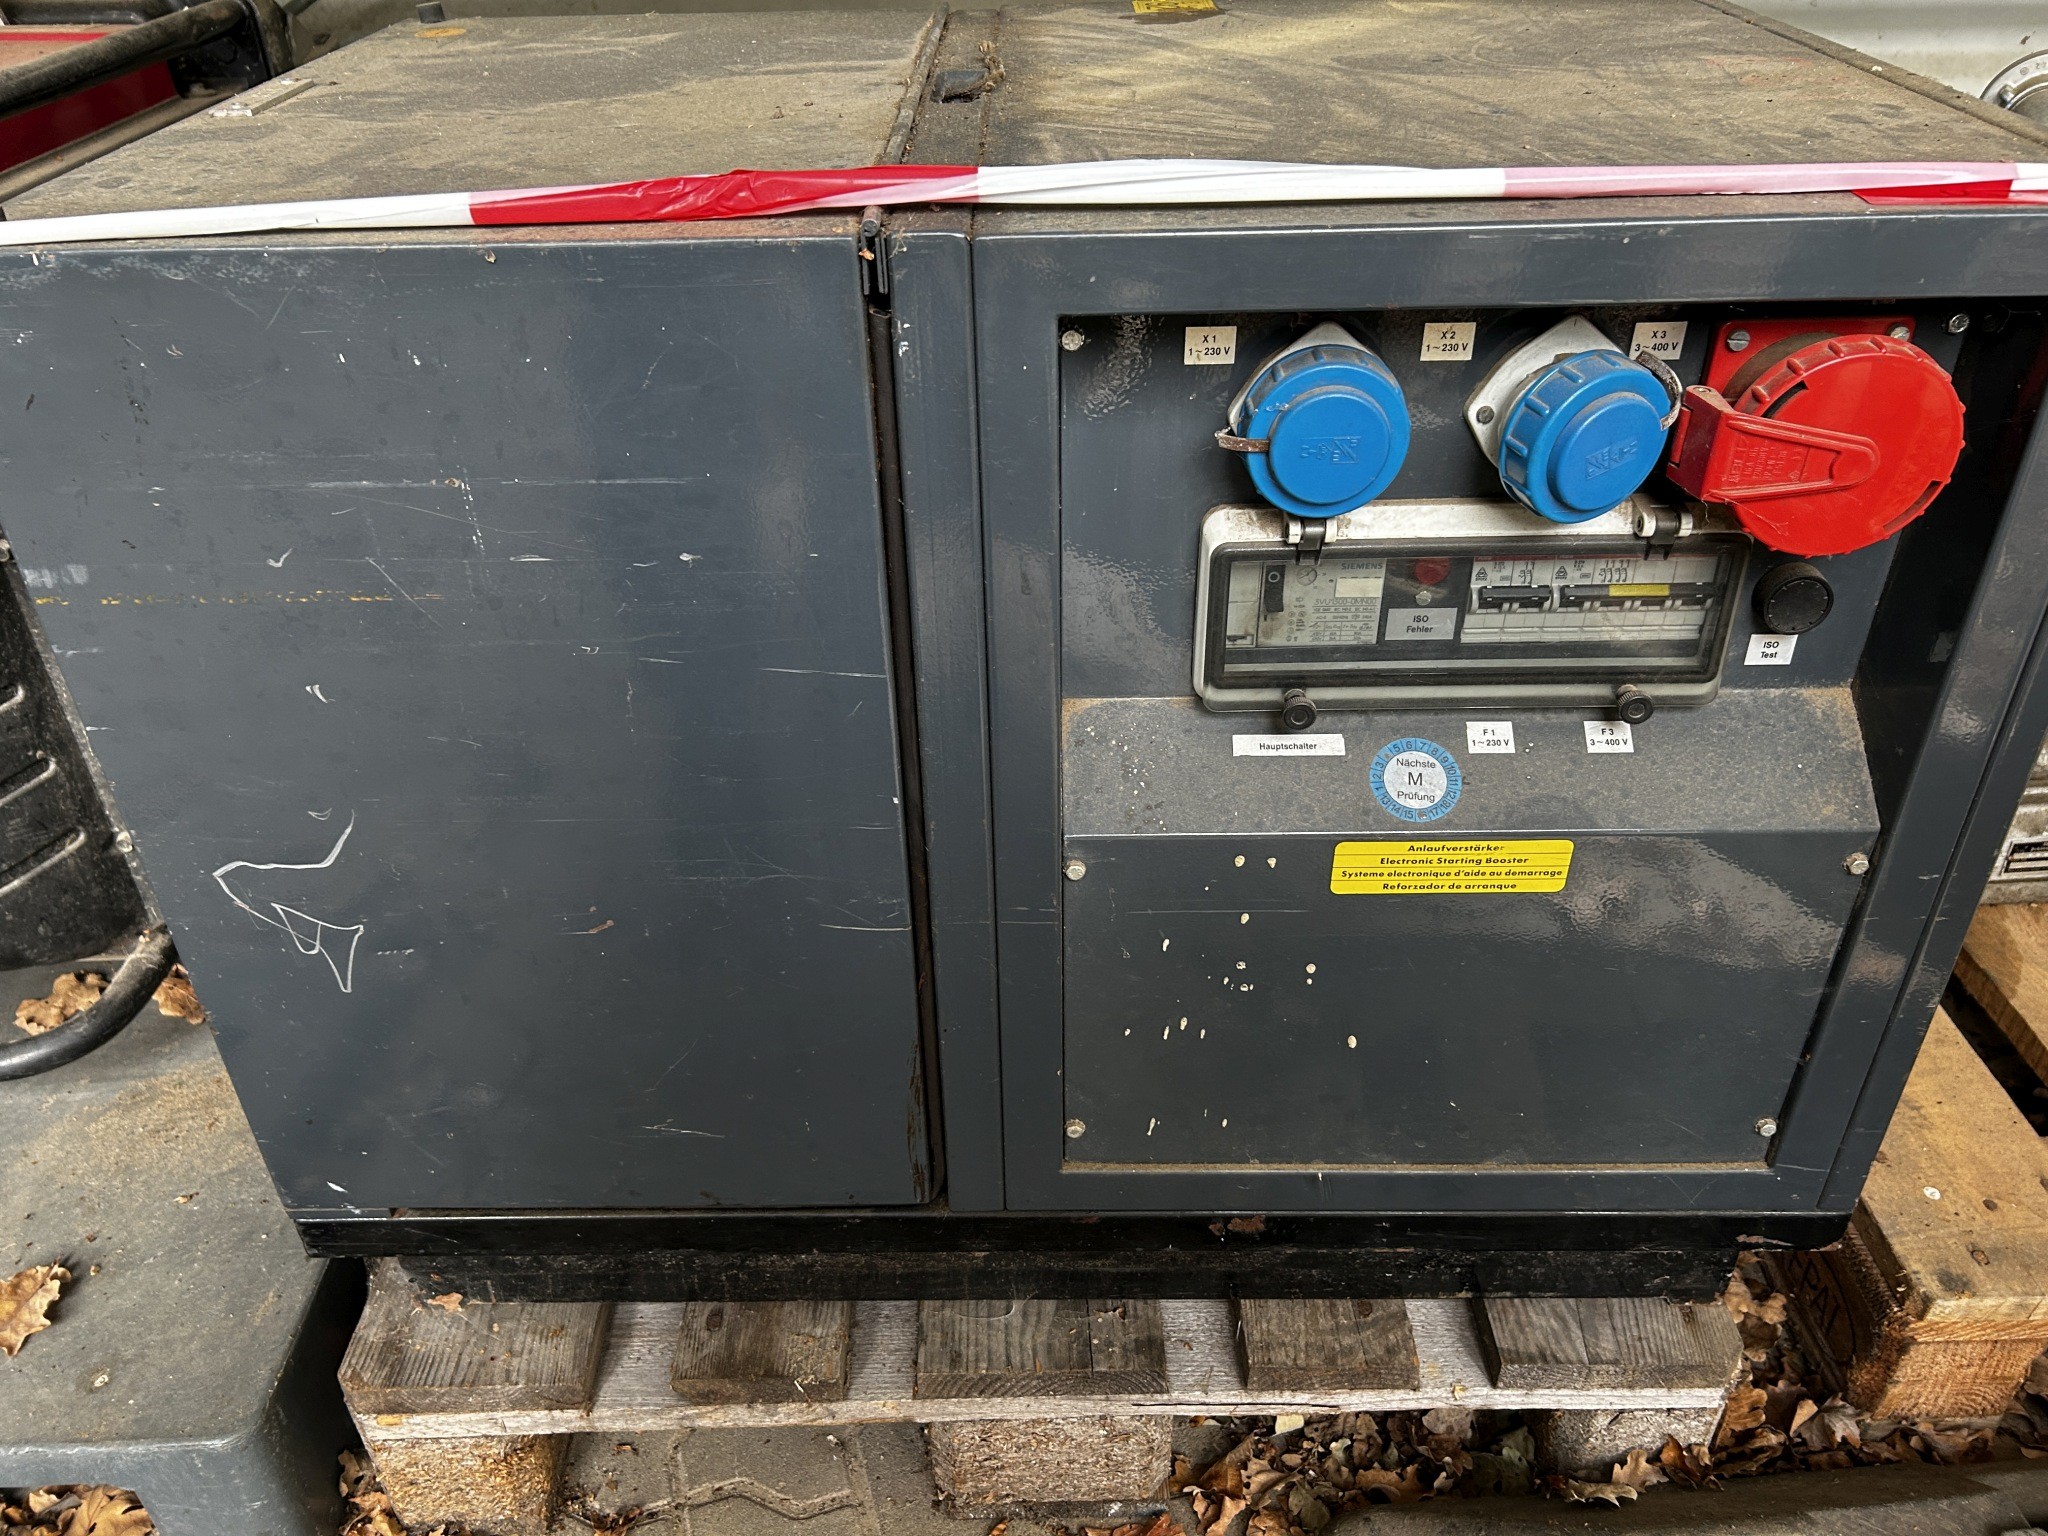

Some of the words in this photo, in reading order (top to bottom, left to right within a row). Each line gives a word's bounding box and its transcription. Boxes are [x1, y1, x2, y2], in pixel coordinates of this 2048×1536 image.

[1202, 334, 1209, 344] X
[1212, 334, 1217, 343] 1
[1440, 330, 1448, 340] X
[1450, 330, 1456, 340] 2
[1651, 330, 1659, 339] X
[1660, 330, 1667, 339] 3
[1223, 346, 1231, 355] V
[1462, 342, 1469, 351] V
[1671, 341, 1679, 351] V
[1341, 562, 1383, 570] SIEMENS
[1412, 614, 1429, 623] ISO
[1406, 625, 1434, 633] Fehler
[1763, 641, 1780, 649] ISO
[1760, 651, 1778, 659] Test
[1483, 728, 1489, 736] F
[1491, 728, 1495, 736] 1
[1601, 728, 1607, 736] F
[1608, 728, 1615, 736] 3
[1405, 740, 1413, 750] 6
[1419, 741, 1427, 750] 7
[1503, 739, 1510, 747] V
[1622, 738, 1628, 746] V
[1259, 742, 1318, 752] Hauptschalter
[1392, 743, 1401, 753] 5
[1431, 747, 1439, 756] 8
[1396, 758, 1436, 769] Nächste
[1440, 756, 1449, 764] 9
[1375, 761, 1384, 769] 3
[1447, 765, 1457, 775] 10
[1408, 771, 1423, 786] M
[1449, 778, 1459, 786] 11
[1397, 790, 1436, 804] Prüfung
[1447, 790, 1458, 800] 12
[1381, 795, 1391, 805] 13
[1390, 804, 1400, 813] 14
[1404, 810, 1414, 819] 15
[1430, 807, 1439, 816] 17
[1440, 800, 1451, 810] 18
[1407, 844, 1505, 852] Anlaufverstärker
[1380, 857, 1434, 865] Electronic
[1436, 857, 1483, 866] Starting
[1341, 870, 1385, 879] Systeme
[1387, 870, 1452, 878] electronique
[1504, 869, 1563, 878] demarrage
[1464, 883, 1517, 891] arranque
